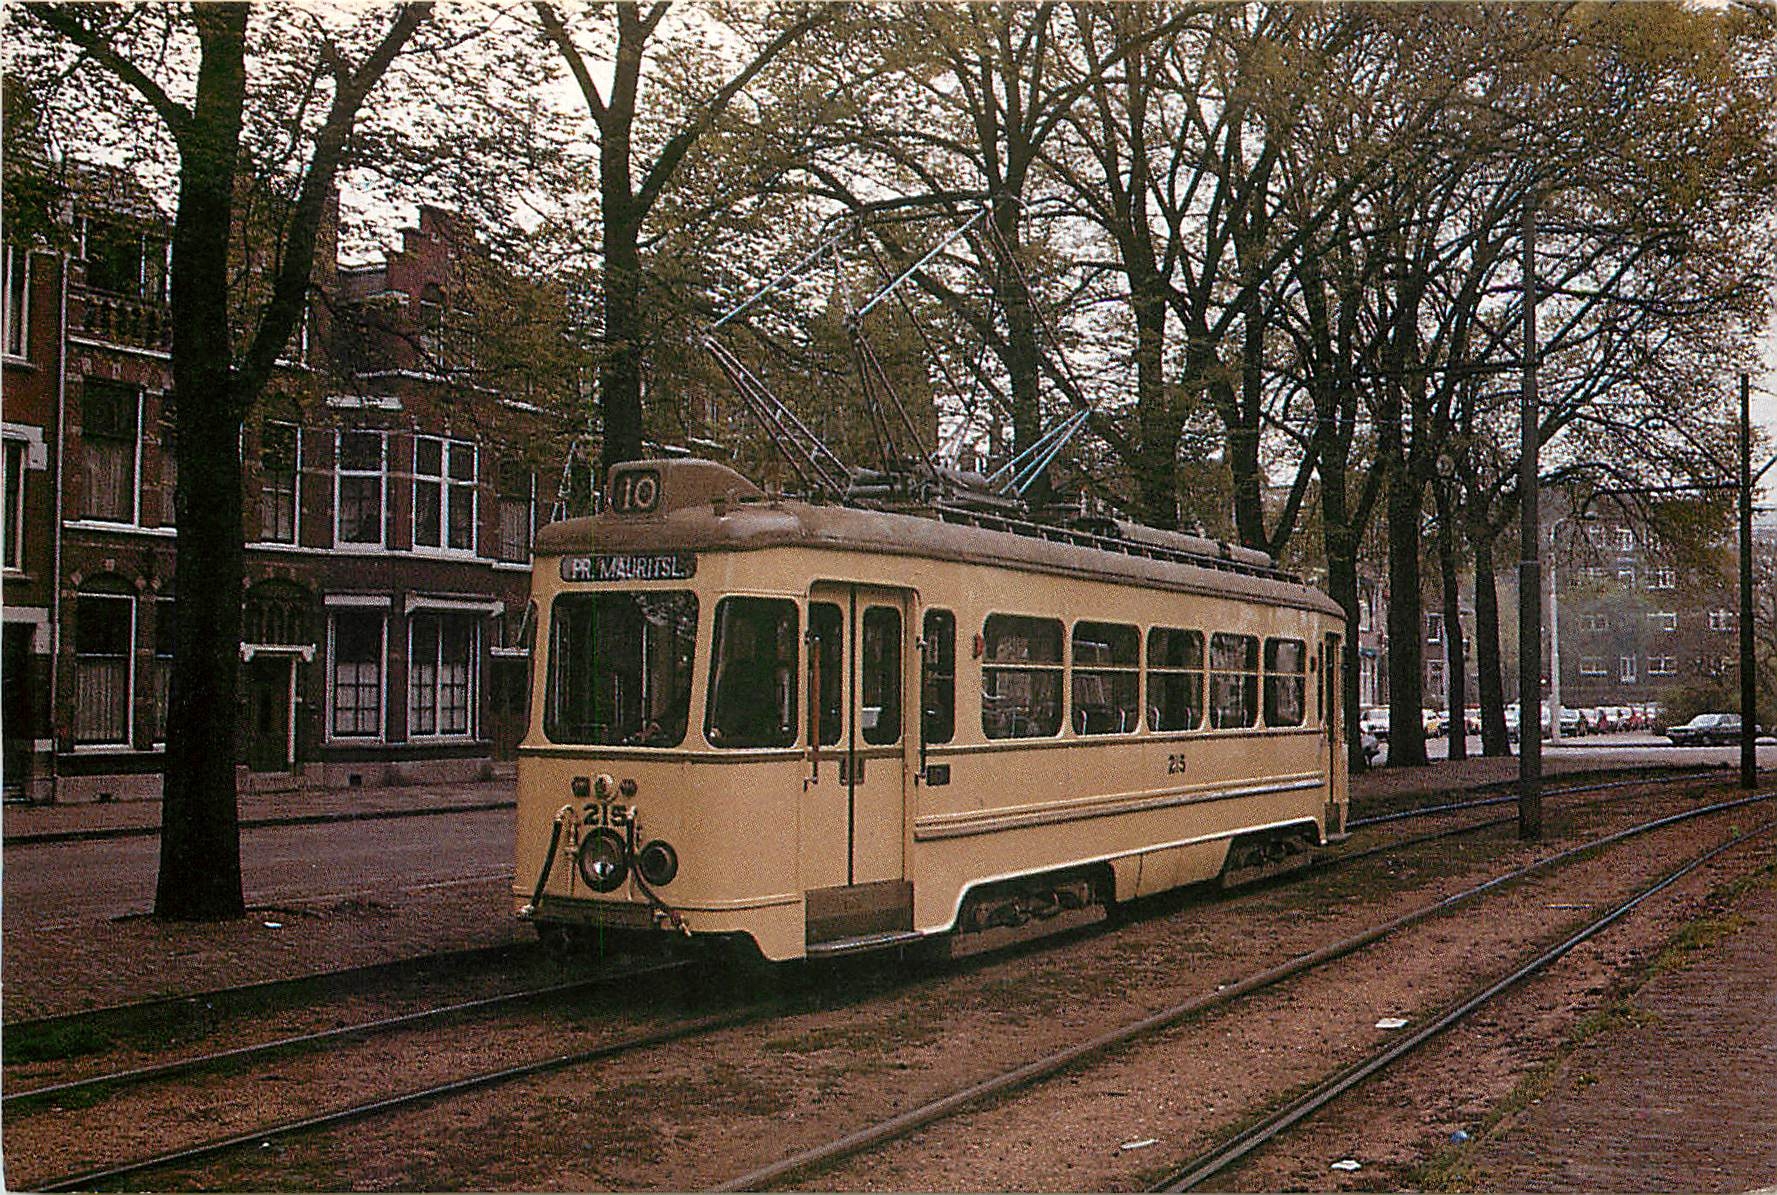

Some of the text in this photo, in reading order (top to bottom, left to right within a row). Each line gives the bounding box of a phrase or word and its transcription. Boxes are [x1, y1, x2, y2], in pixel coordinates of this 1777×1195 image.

[623, 477, 657, 509] 10
[572, 558, 595, 579] PR.
[583, 800, 627, 826] 215
